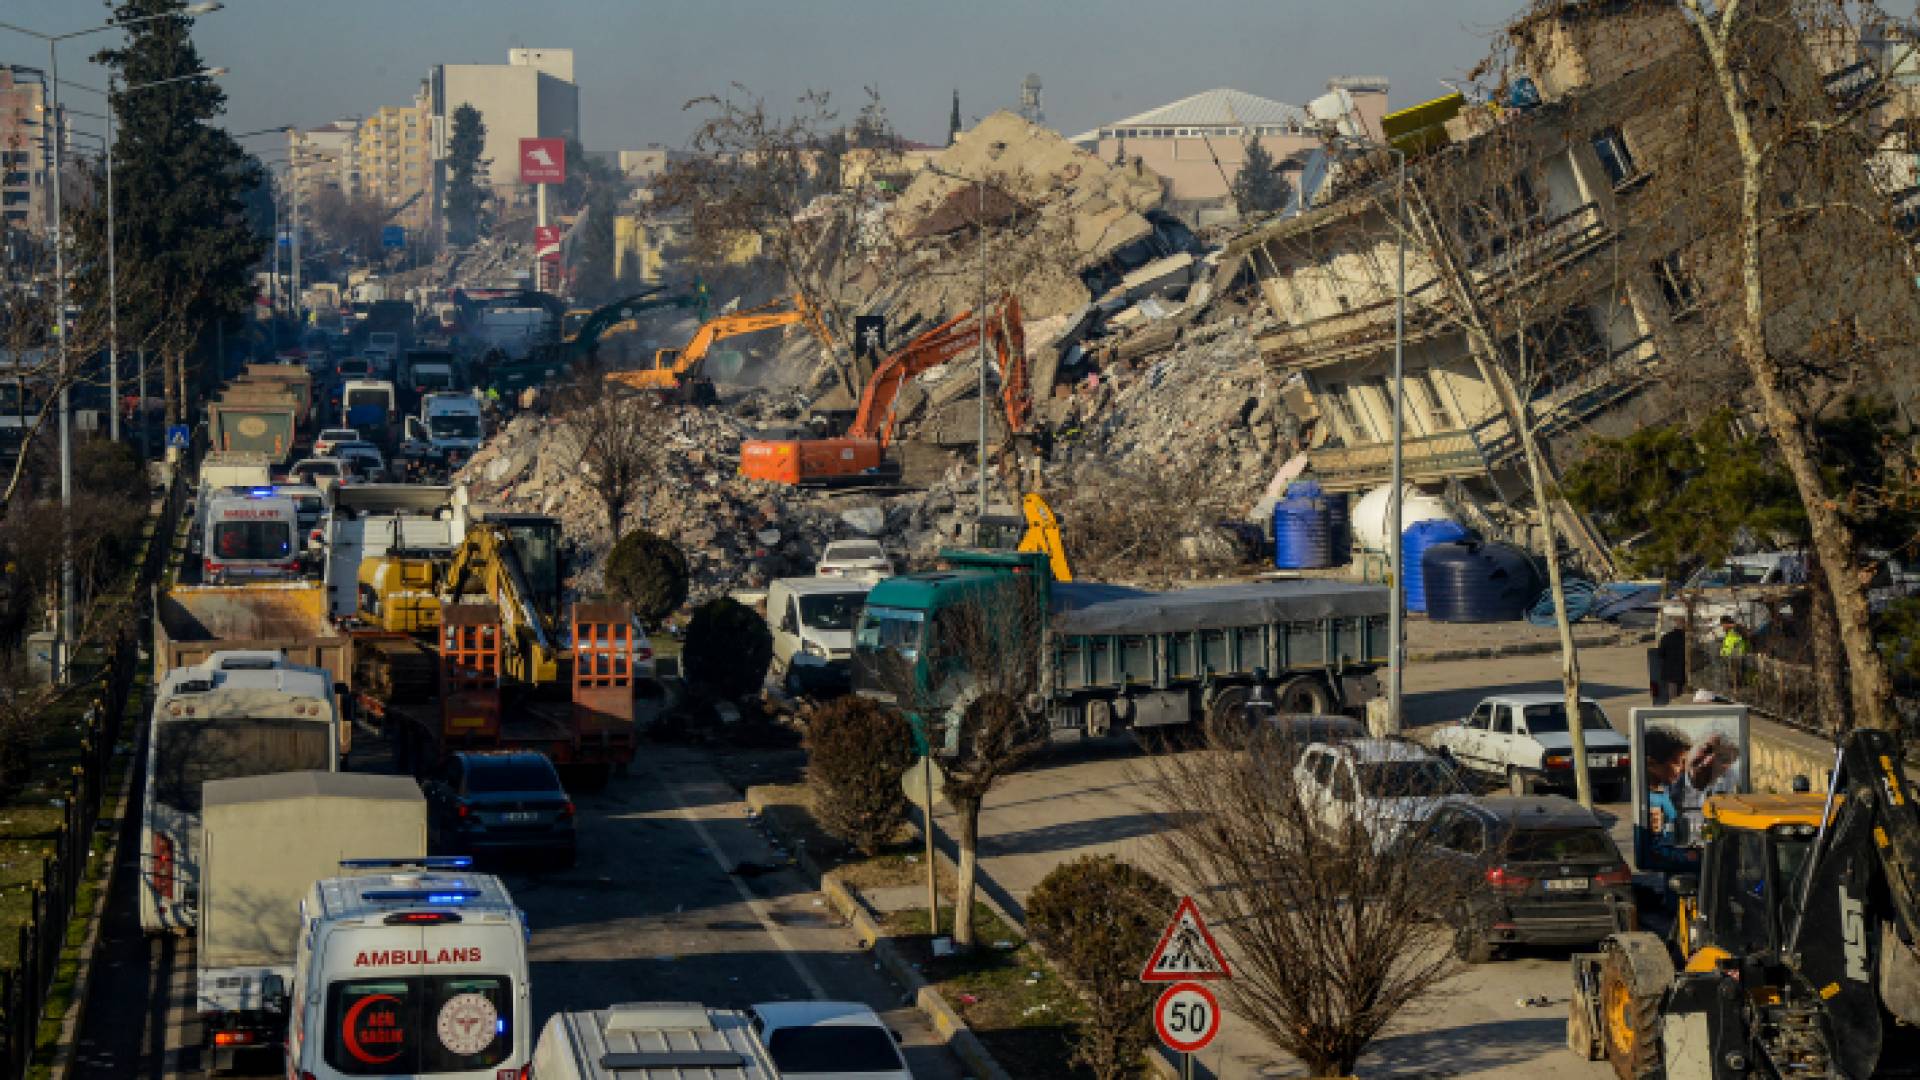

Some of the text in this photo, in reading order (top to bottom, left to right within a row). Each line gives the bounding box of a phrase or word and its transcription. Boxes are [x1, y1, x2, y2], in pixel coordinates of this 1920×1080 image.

[1839, 885, 1869, 983] MST
[353, 947, 482, 968] AMBULANS
[1169, 1001, 1206, 1034] 50
